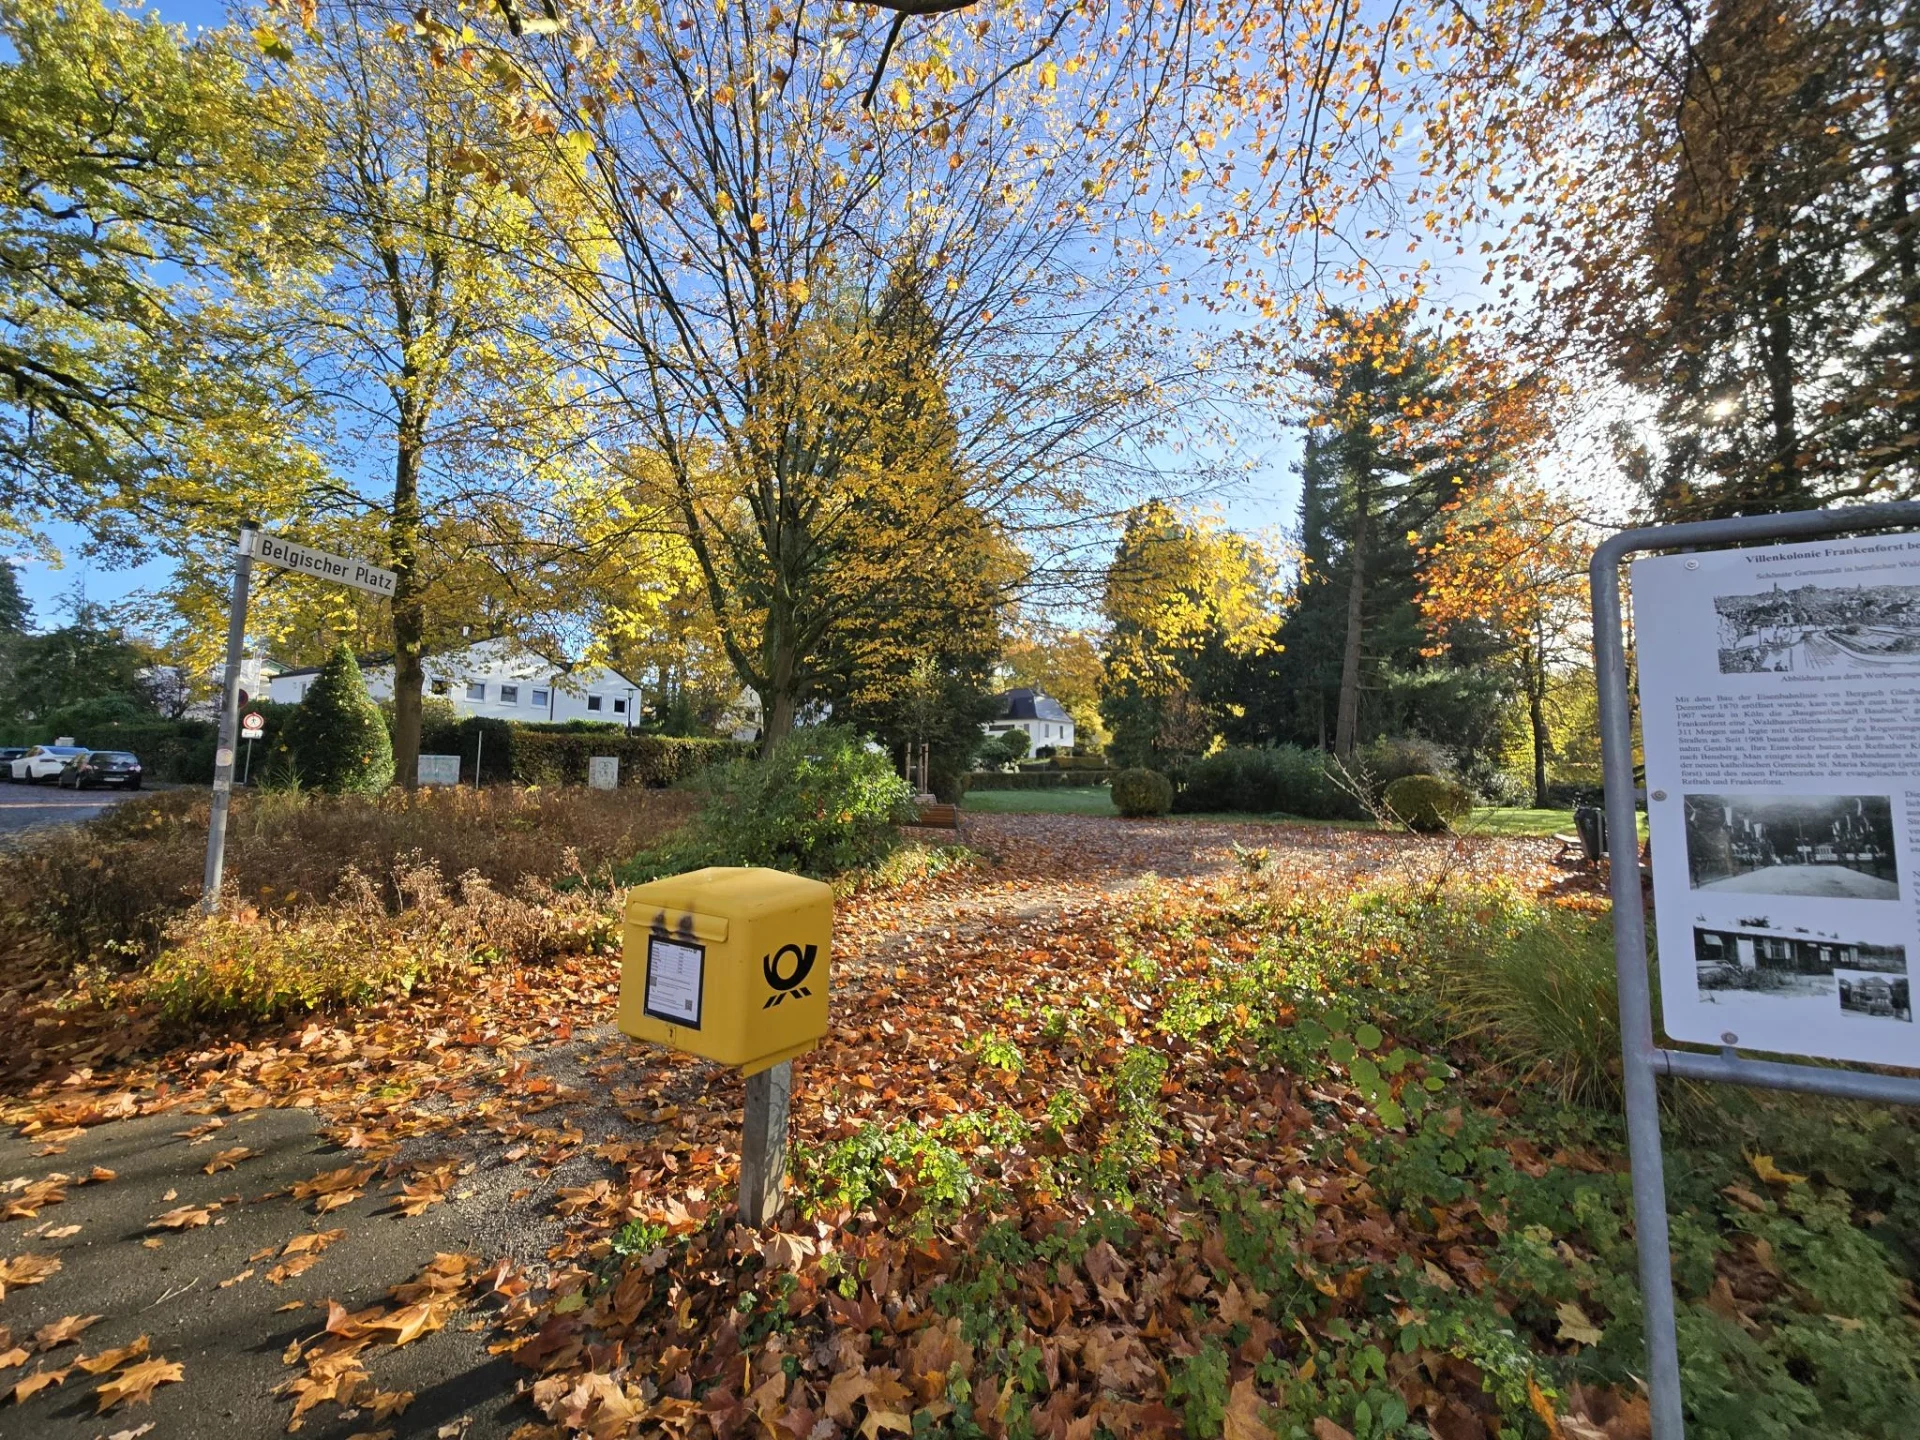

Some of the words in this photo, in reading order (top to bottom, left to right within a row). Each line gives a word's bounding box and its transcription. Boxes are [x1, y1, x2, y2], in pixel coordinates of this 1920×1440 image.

[1746, 550, 1821, 563] Villenkolonie
[1825, 542, 1903, 556] Frankenforst
[262, 540, 348, 577] Belgischer
[356, 567, 392, 590] Platz
[1748, 727, 1768, 735] legte
[1765, 752, 1792, 760] einigte
[1846, 770, 1908, 778] evangelischen
